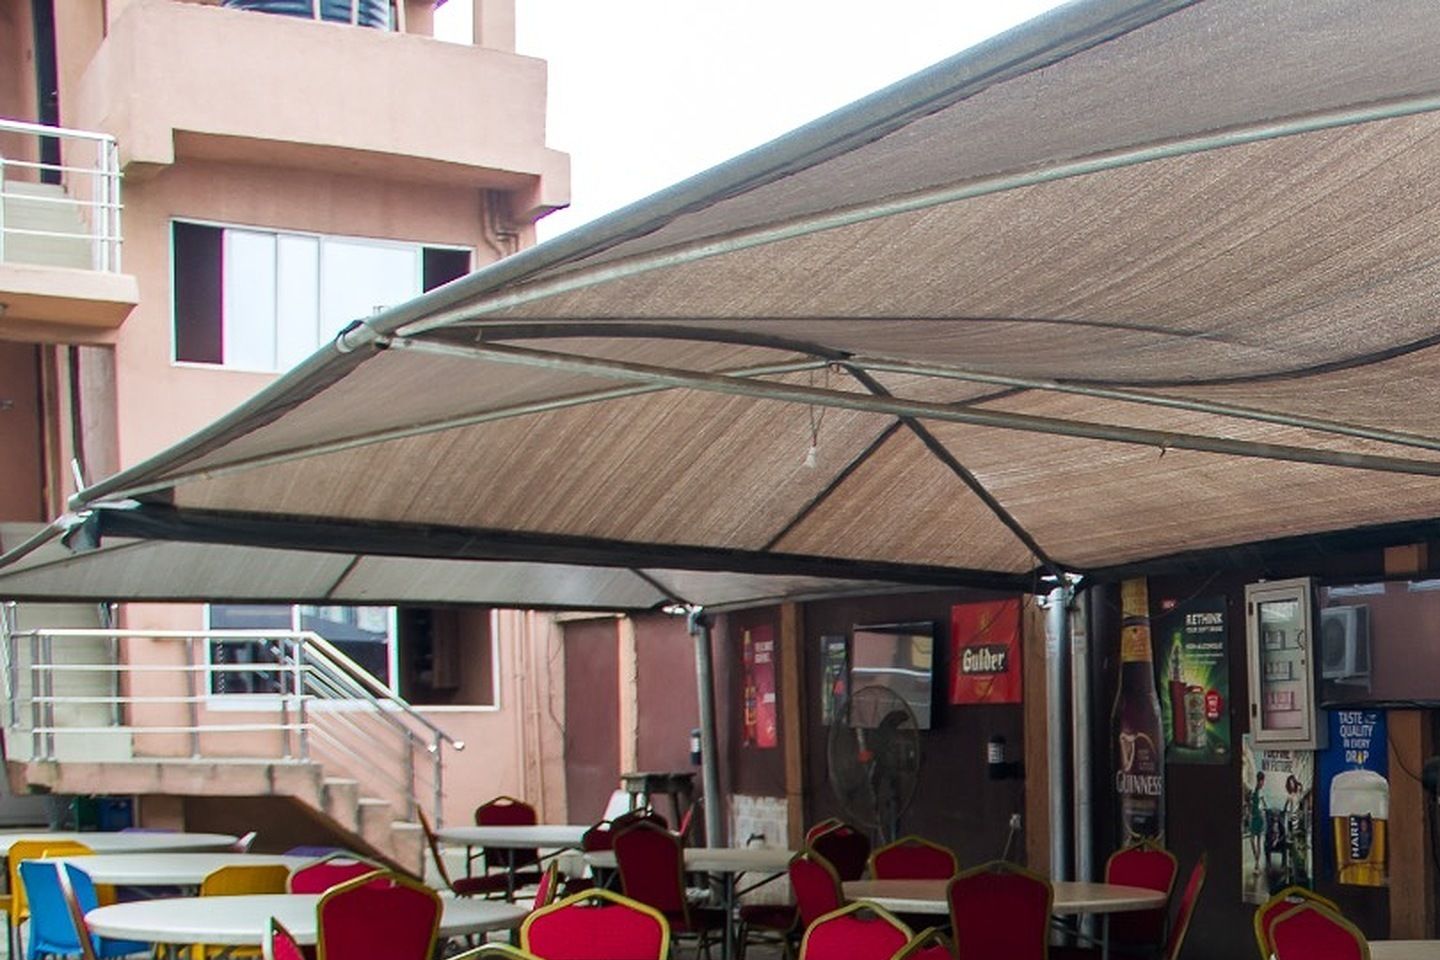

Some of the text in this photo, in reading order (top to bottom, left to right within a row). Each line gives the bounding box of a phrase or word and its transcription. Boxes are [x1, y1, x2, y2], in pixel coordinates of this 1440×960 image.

[962, 648, 1005, 672] Gulder
[1338, 712, 1363, 724] TASTE
[1340, 725, 1373, 738] QUALITY
[1351, 738, 1371, 749] EVERY
[1116, 770, 1162, 795] GUINNESS
[1351, 817, 1360, 858] HARP
